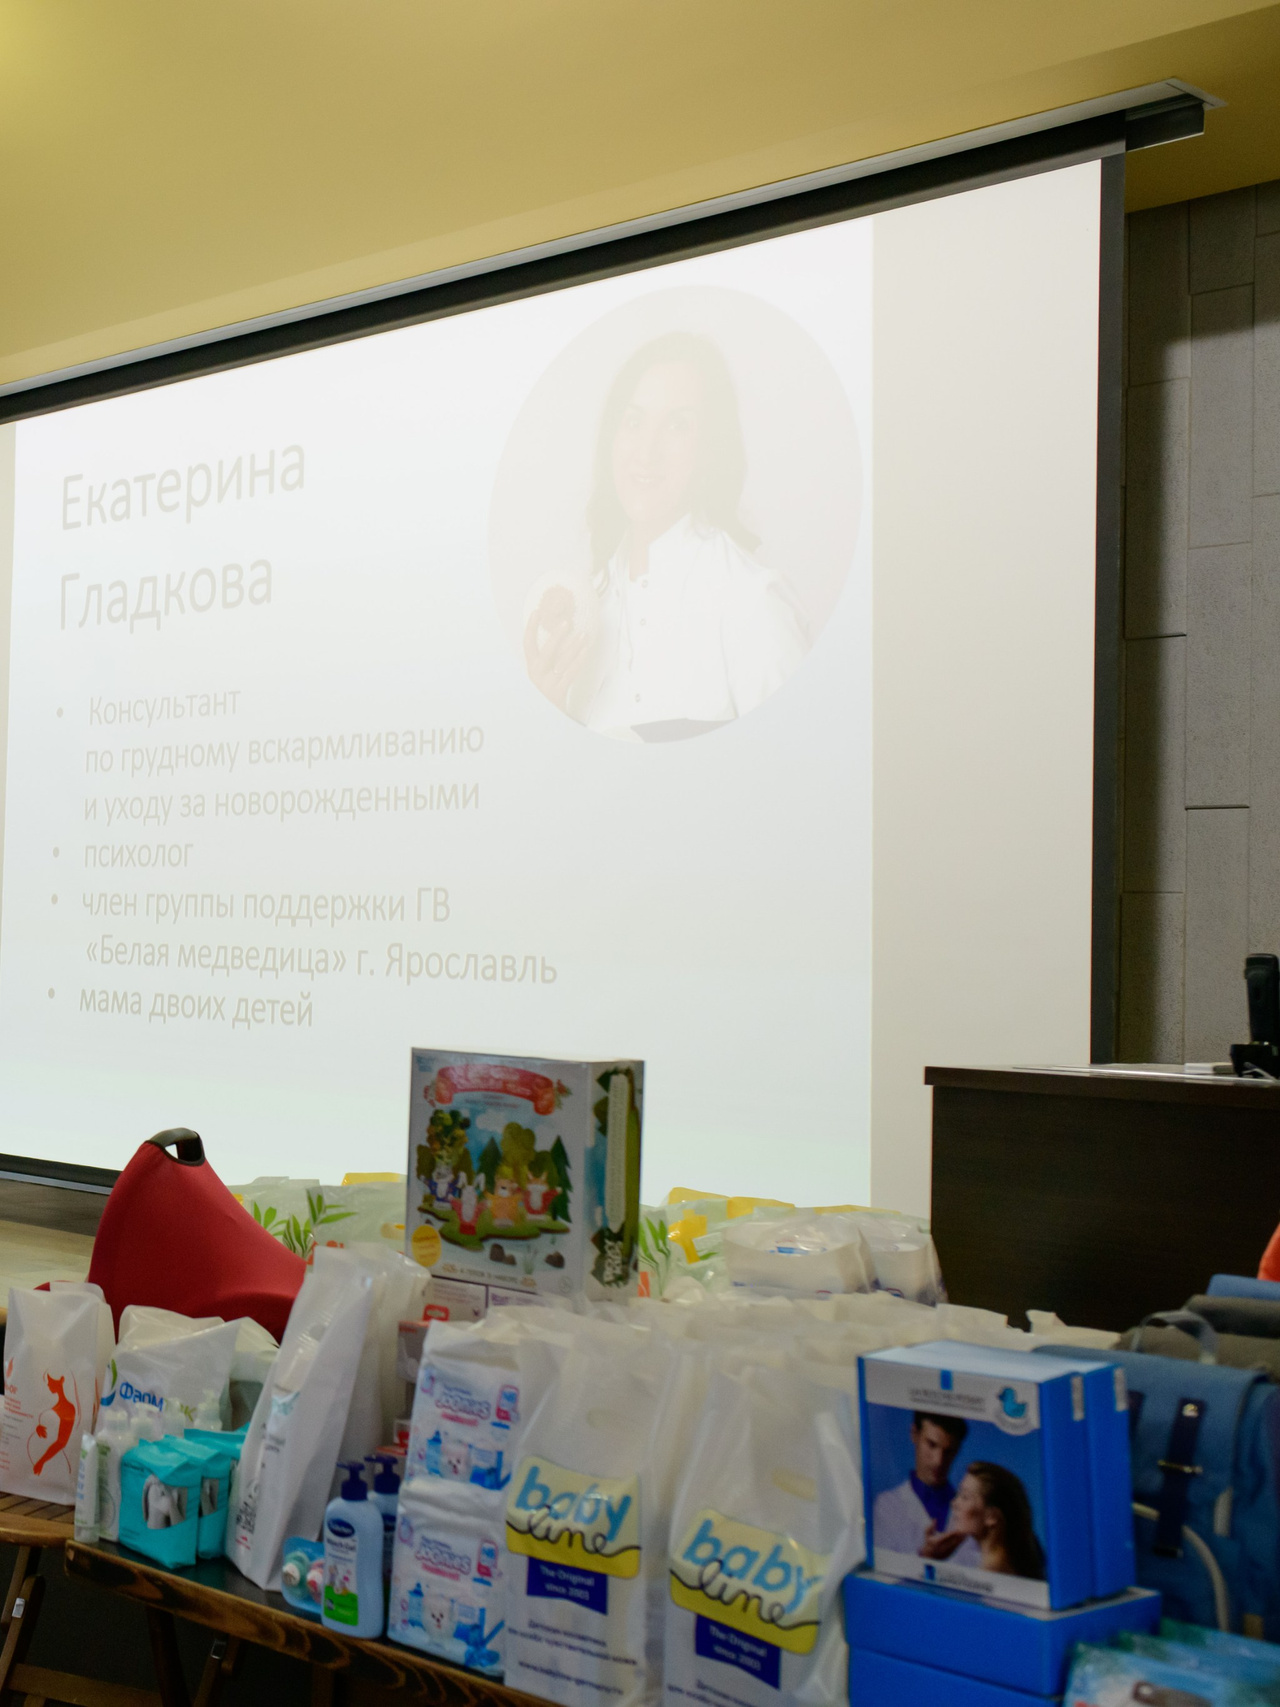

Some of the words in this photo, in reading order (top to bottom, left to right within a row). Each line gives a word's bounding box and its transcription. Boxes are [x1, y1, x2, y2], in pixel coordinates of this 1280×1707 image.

[61, 443, 306, 531] Екатерина
[59, 556, 274, 634] Гладкова
[88, 689, 242, 728] Консультант
[85, 747, 114, 774] по
[121, 738, 240, 777] грудному
[247, 724, 485, 768] вскармливанию
[83, 798, 97, 821] и
[104, 789, 174, 827] уходу
[179, 789, 206, 818] за
[214, 781, 480, 822] новорожденными
[83, 841, 195, 869] психолог
[82, 891, 138, 917] член
[145, 891, 234, 924] группы
[242, 892, 406, 928] поддержки
[416, 887, 451, 923] ГВ
[85, 934, 170, 968] «Белая
[177, 942, 347, 981] медведица»
[356, 949, 376, 976] г.
[385, 942, 558, 987] Ярославль
[79, 987, 143, 1015] мама
[149, 992, 227, 1024] двоих
[231, 991, 315, 1030] детей
[506, 1504, 641, 1558] line
[515, 1466, 632, 1543] baby
[683, 1519, 822, 1614] baby
[669, 1558, 821, 1630] line
